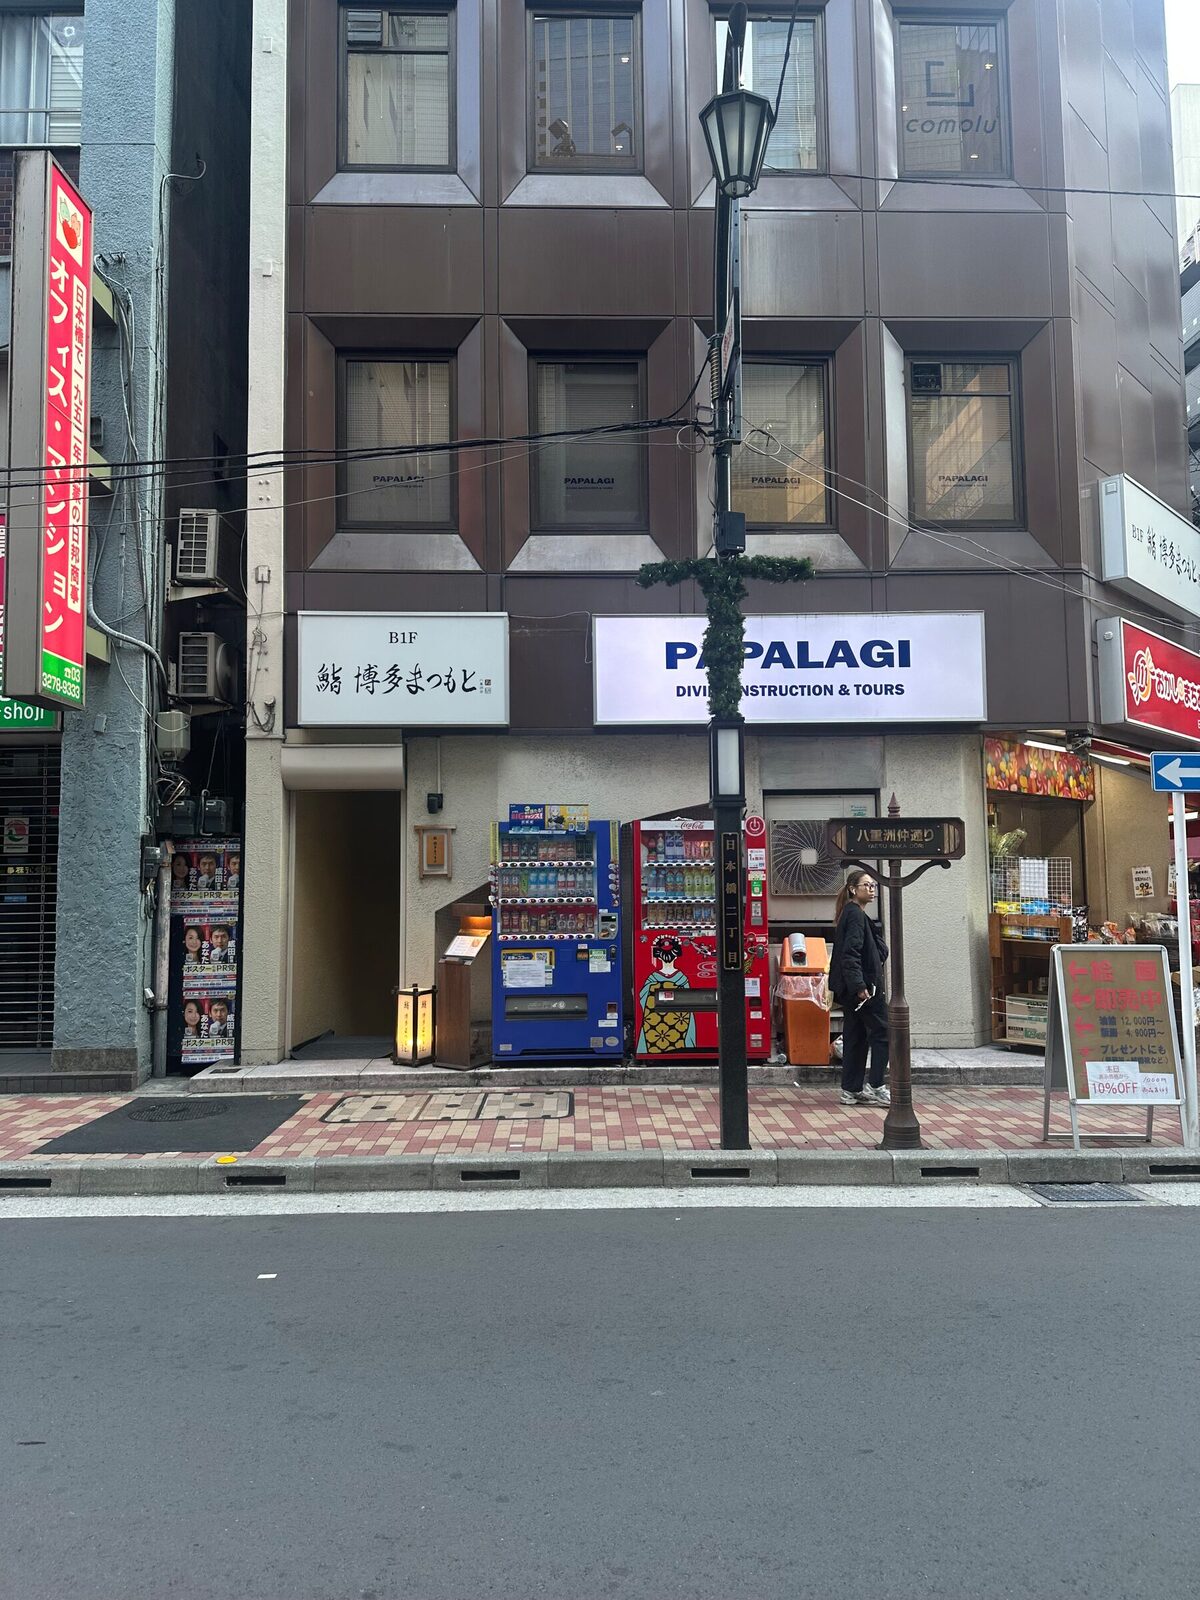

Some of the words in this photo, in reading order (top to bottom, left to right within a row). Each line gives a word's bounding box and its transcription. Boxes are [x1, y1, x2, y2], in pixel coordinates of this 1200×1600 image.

[906, 114, 996, 134] comolu
[45, 256, 69, 633] オフィス・マンション
[1131, 524, 1144, 542] B1F
[388, 631, 418, 644] B1F
[665, 639, 912, 670] PPALAGI
[71, 669, 81, 682] 03
[315, 663, 343, 695] 鮨
[354, 663, 478, 695] 博多まつもと
[42, 672, 80, 699] 3278-9333
[676, 685, 710, 697] DIVI
[741, 684, 835, 697] NSTRUCTION
[838, 684, 850, 696] &
[853, 684, 905, 696] TOURS
[0, 702, 44, 721] shoji
[857, 828, 935, 842] 八重洲仲通り
[725, 839, 738, 963] 日本橋二丁目
[1100, 1044, 1167, 1056] プレゼントにも
[1092, 1082, 1138, 1094] 10%OFF
